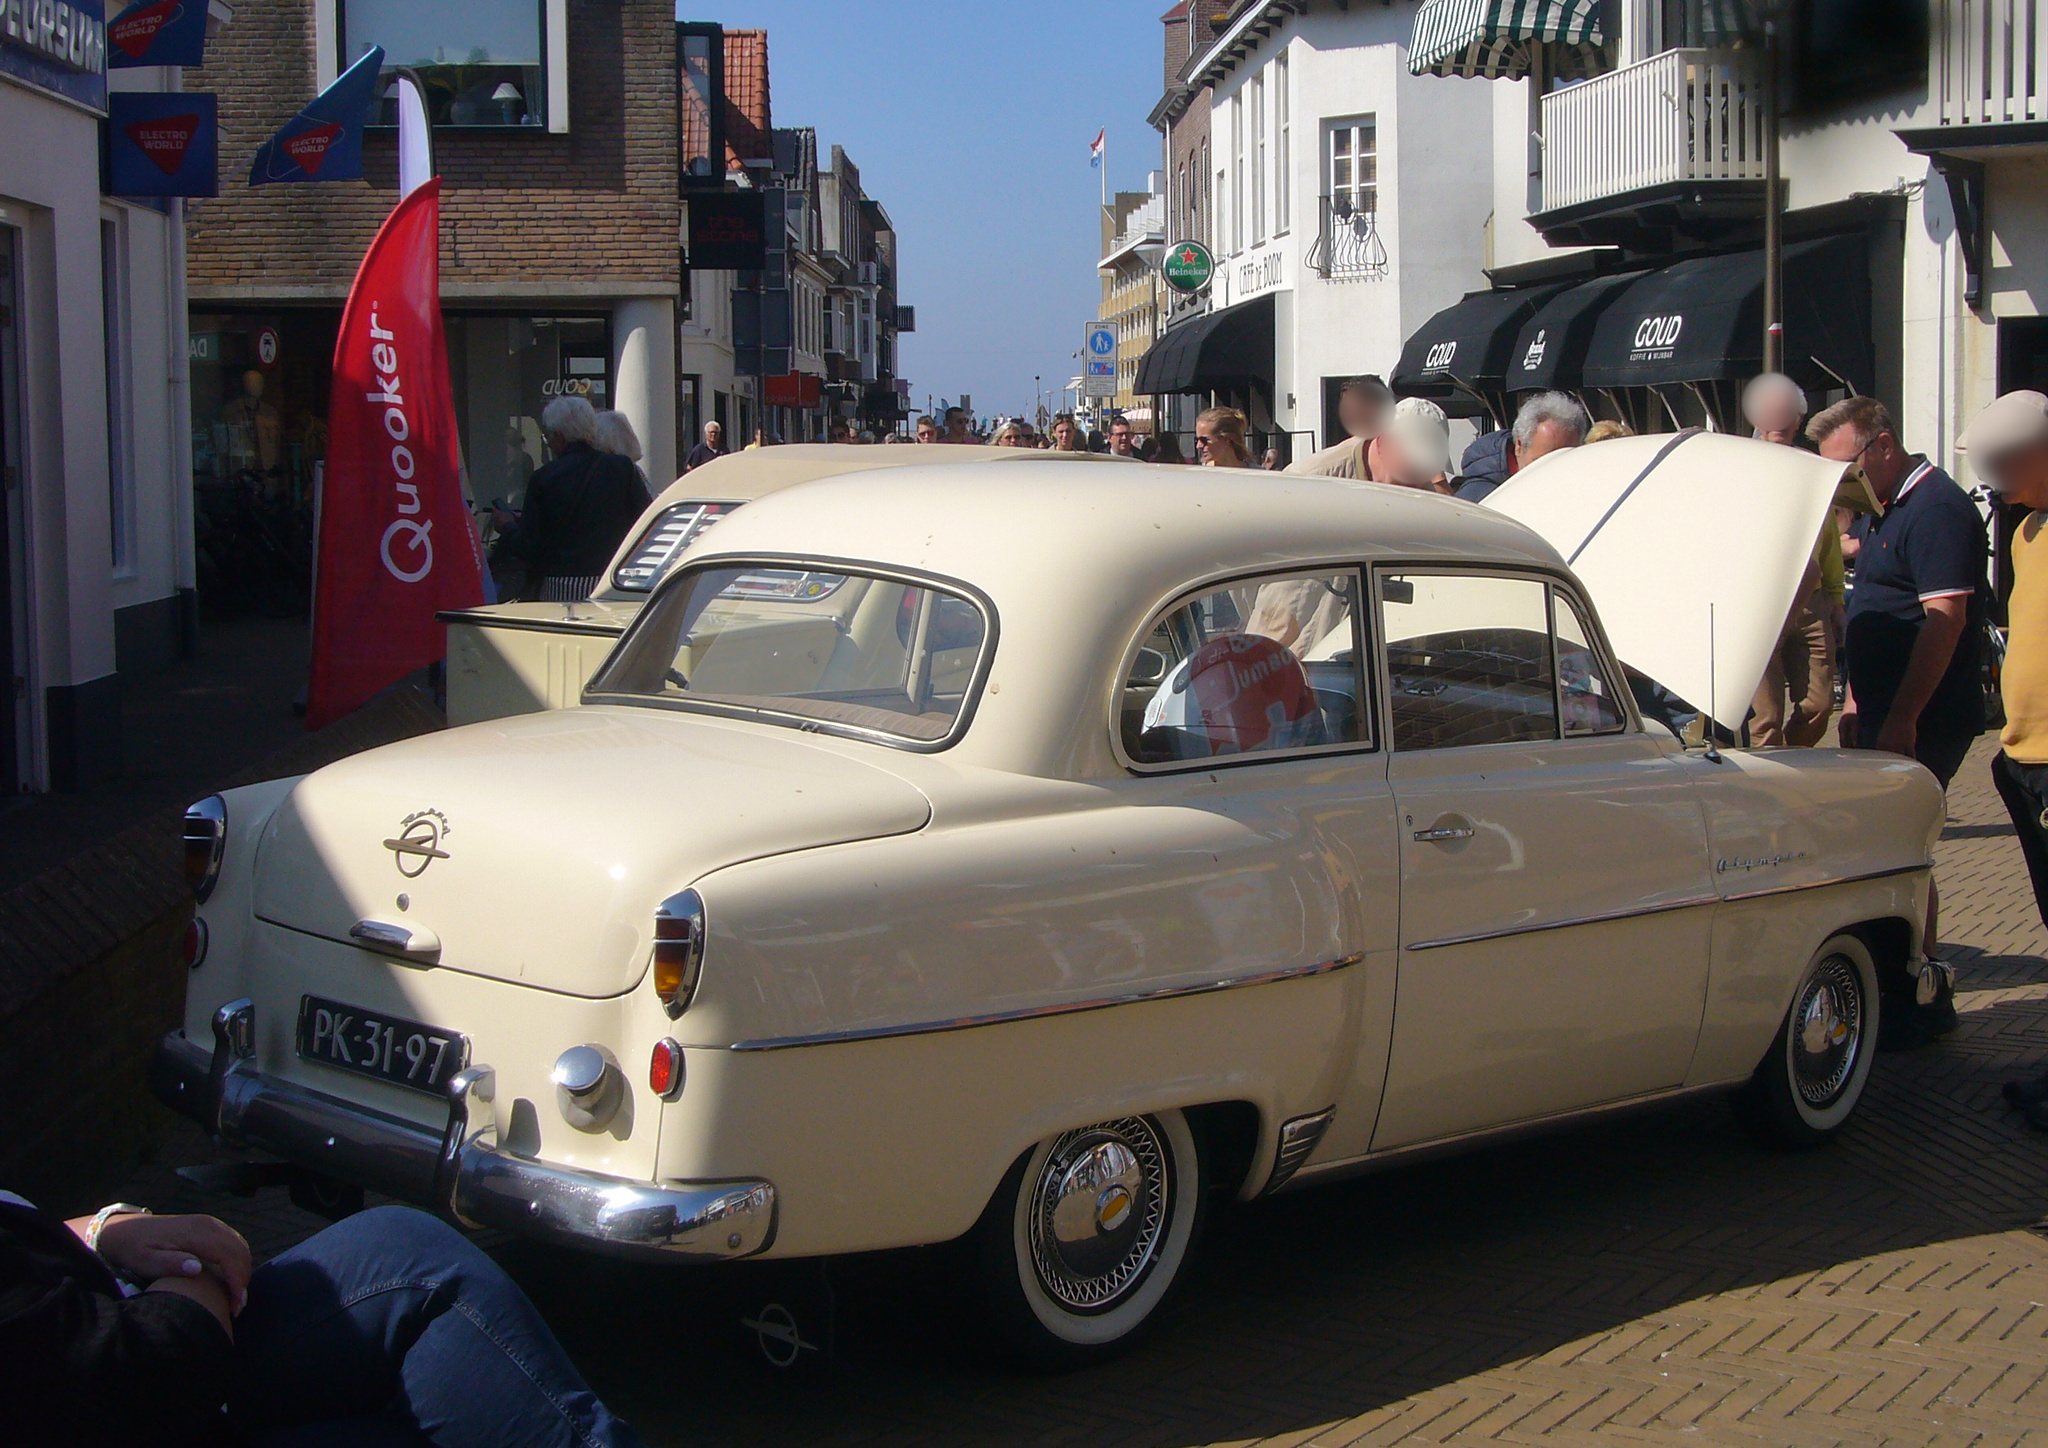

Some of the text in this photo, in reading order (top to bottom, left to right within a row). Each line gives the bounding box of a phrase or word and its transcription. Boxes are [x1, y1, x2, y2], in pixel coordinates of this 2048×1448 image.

[114, 14, 163, 32] ELECTRO
[115, 25, 156, 40] WORLD
[139, 130, 188, 140] ELECTRO
[291, 136, 329, 148] ELECTRO
[144, 140, 184, 150] WORLD
[291, 144, 325, 154] WORLD
[1169, 267, 1208, 277] Heineken
[1263, 252, 1282, 288] BOOM
[1634, 315, 1682, 348] GOUD
[366, 312, 433, 583] Quooker
[313, 1008, 450, 1085] PK-31-97
